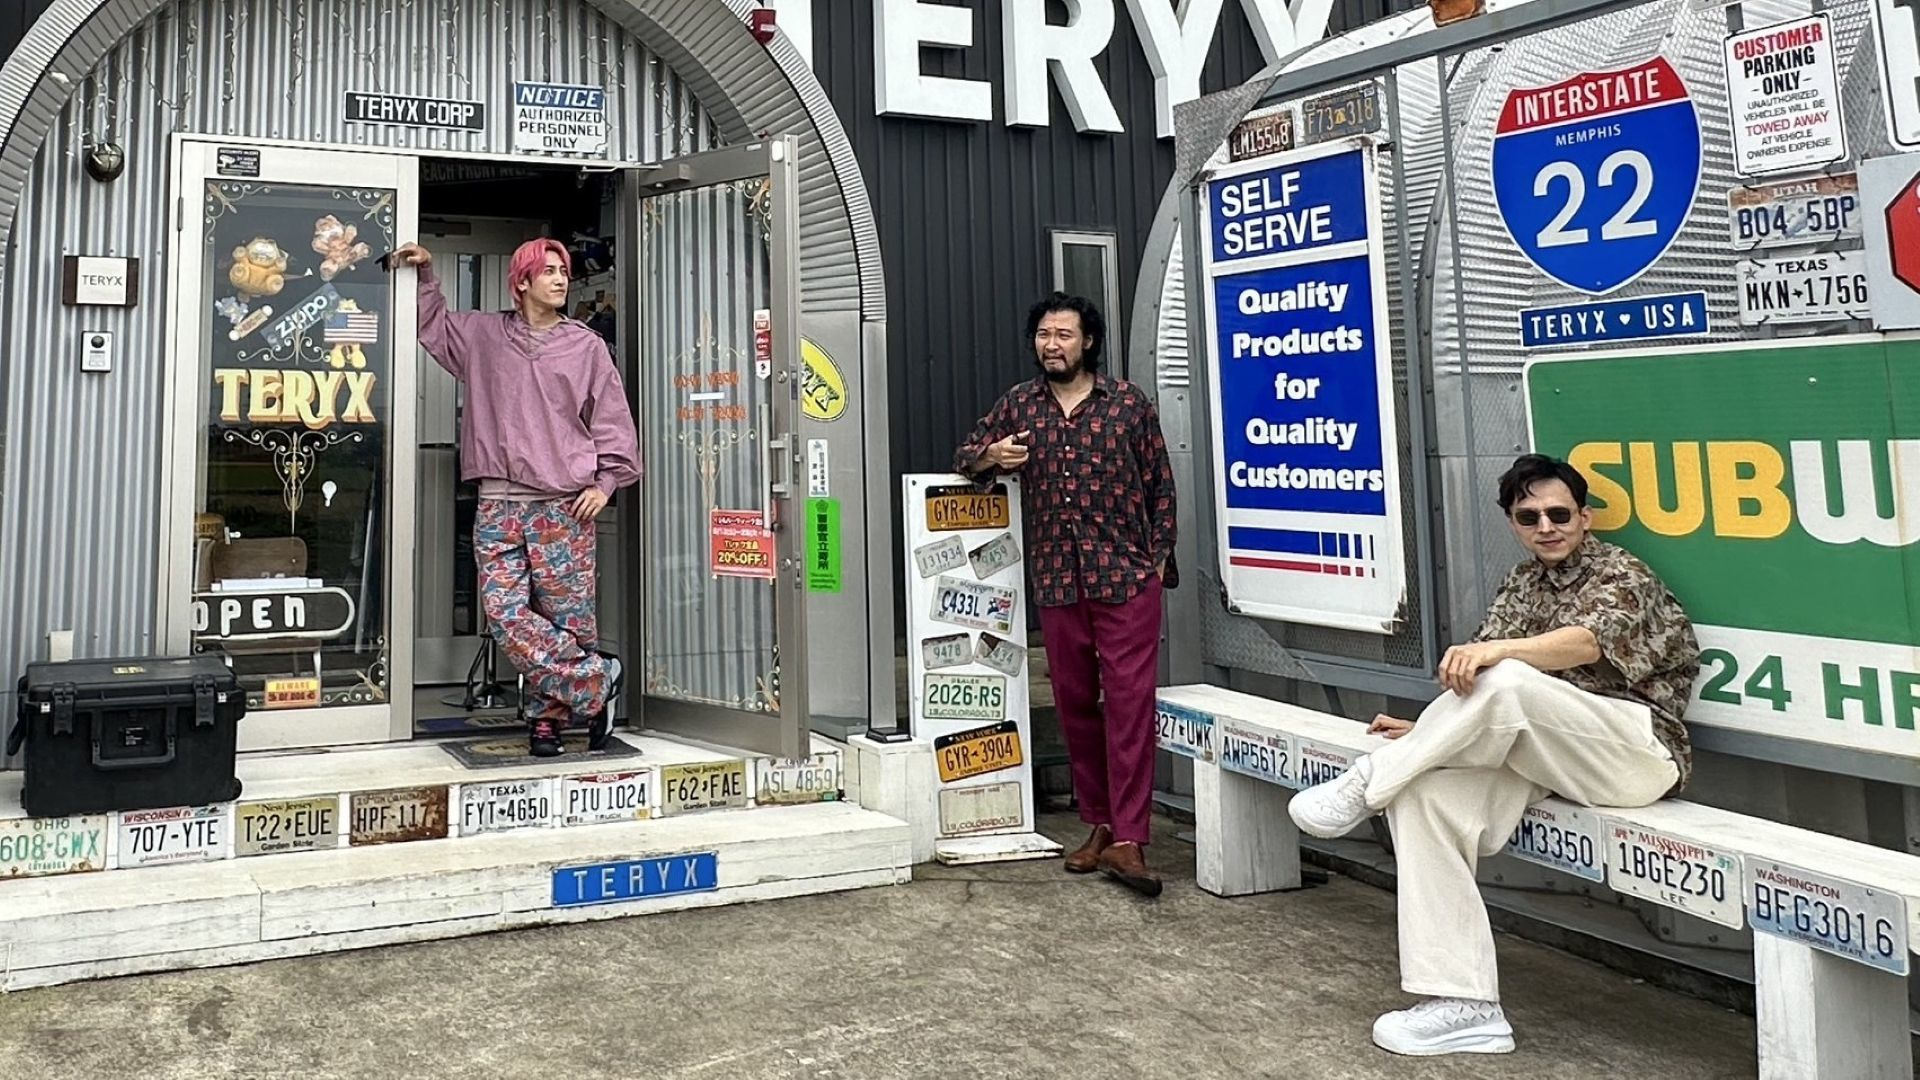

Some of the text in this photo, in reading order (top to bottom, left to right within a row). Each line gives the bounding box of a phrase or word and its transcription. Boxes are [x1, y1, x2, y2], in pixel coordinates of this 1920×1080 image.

[1734, 23, 1823, 60] CUSTOMER
[773, 0, 1330, 140] ERY
[1744, 46, 1815, 78] PARKING
[520, 86, 599, 108] NOTICE
[1516, 68, 1661, 126] INTERSTATE
[1763, 71, 1800, 95] ONLY
[355, 95, 475, 127] TERYX CORP
[1347, 98, 1374, 125] 318
[1744, 99, 1825, 121] VEHICLES WILL BE
[1747, 89, 1819, 110] UNAUTHORIZED
[518, 108, 602, 124] AUTHORIZED
[519, 121, 602, 137] PERSONNEL
[1745, 111, 1829, 137] TOWED AWAY
[543, 135, 577, 149] ONLY
[1556, 124, 1621, 147] MEMPHIS
[1747, 137, 1832, 160] OWNERS EXPENSE
[1761, 129, 1813, 145] AT VEHICLE
[1221, 171, 1300, 218] SELF
[1533, 150, 1658, 249] 22
[1773, 183, 1818, 198] UTAH
[1223, 205, 1332, 256] SERVE
[82, 275, 122, 286] TERYX
[1775, 259, 1828, 274] TEXAS
[1238, 281, 1349, 315] Quality
[275, 296, 327, 338] zippo
[1531, 302, 1695, 340] TERYX USA
[1232, 327, 1363, 358] Products
[215, 368, 377, 430] TERYX
[800, 357, 840, 413] RYX
[1274, 373, 1320, 401] for
[1246, 417, 1358, 451] Quality
[1229, 460, 1384, 493] Customers
[922, 545, 962, 569] 131934
[942, 590, 980, 617] C433L
[933, 644, 961, 658] 9478
[1699, 648, 1792, 712] 24
[941, 708, 990, 718] COLORADO
[1223, 736, 1289, 779] AWP5612
[489, 785, 526, 796] TEXAS
[763, 769, 832, 797] ASL 4859
[570, 783, 646, 814] PIU 1024
[33, 819, 70, 831] OHIO
[125, 809, 182, 823] WISCONSIN
[130, 819, 219, 854] 707-YTE
[1639, 832, 1705, 861] MISSISSIPPI
[573, 858, 698, 900] TERYX
[1619, 842, 1725, 902] 1BGE230
[1756, 868, 1840, 900] WASHINGTON
[1660, 890, 1686, 906] LEE
[1755, 883, 1893, 957] BFG3016
